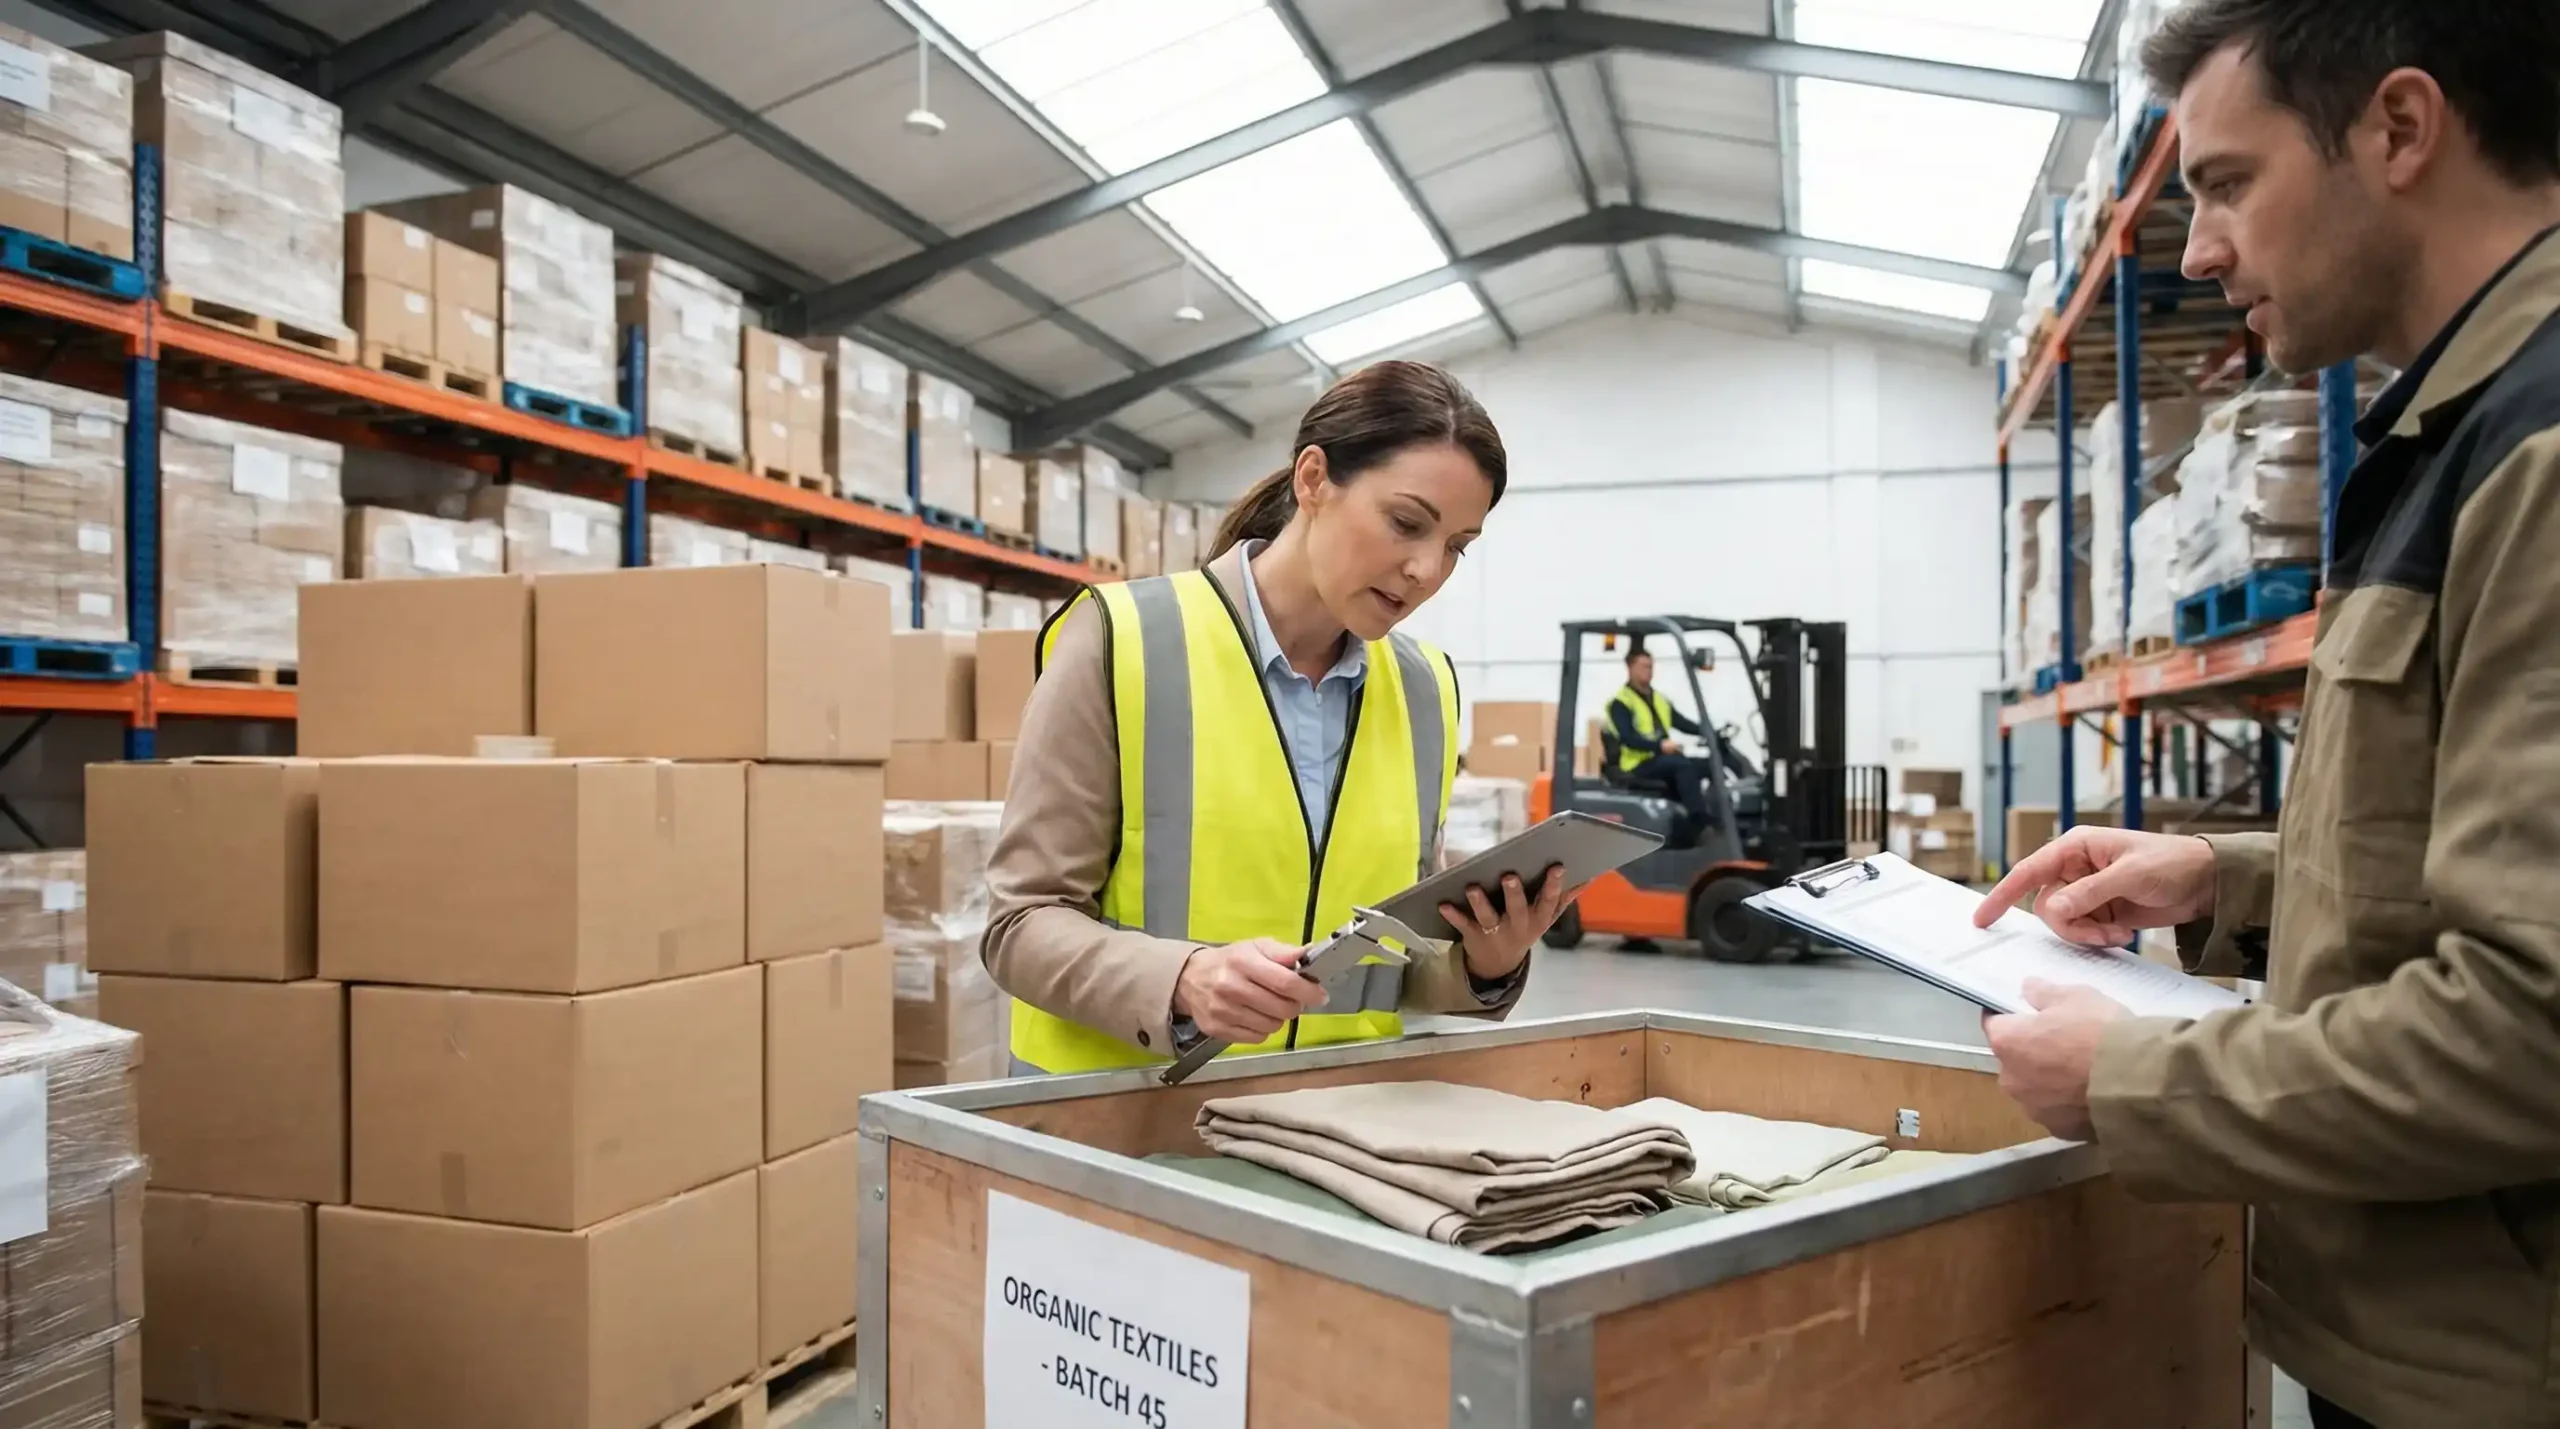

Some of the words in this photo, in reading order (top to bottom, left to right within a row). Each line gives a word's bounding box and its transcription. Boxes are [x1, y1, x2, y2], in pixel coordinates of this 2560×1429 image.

[1004, 1276, 1102, 1342] ORGANIC
[1108, 1316, 1219, 1389] TEXTILES
[1056, 1356, 1130, 1416] BATCH
[1137, 1393, 1168, 1429] 45
